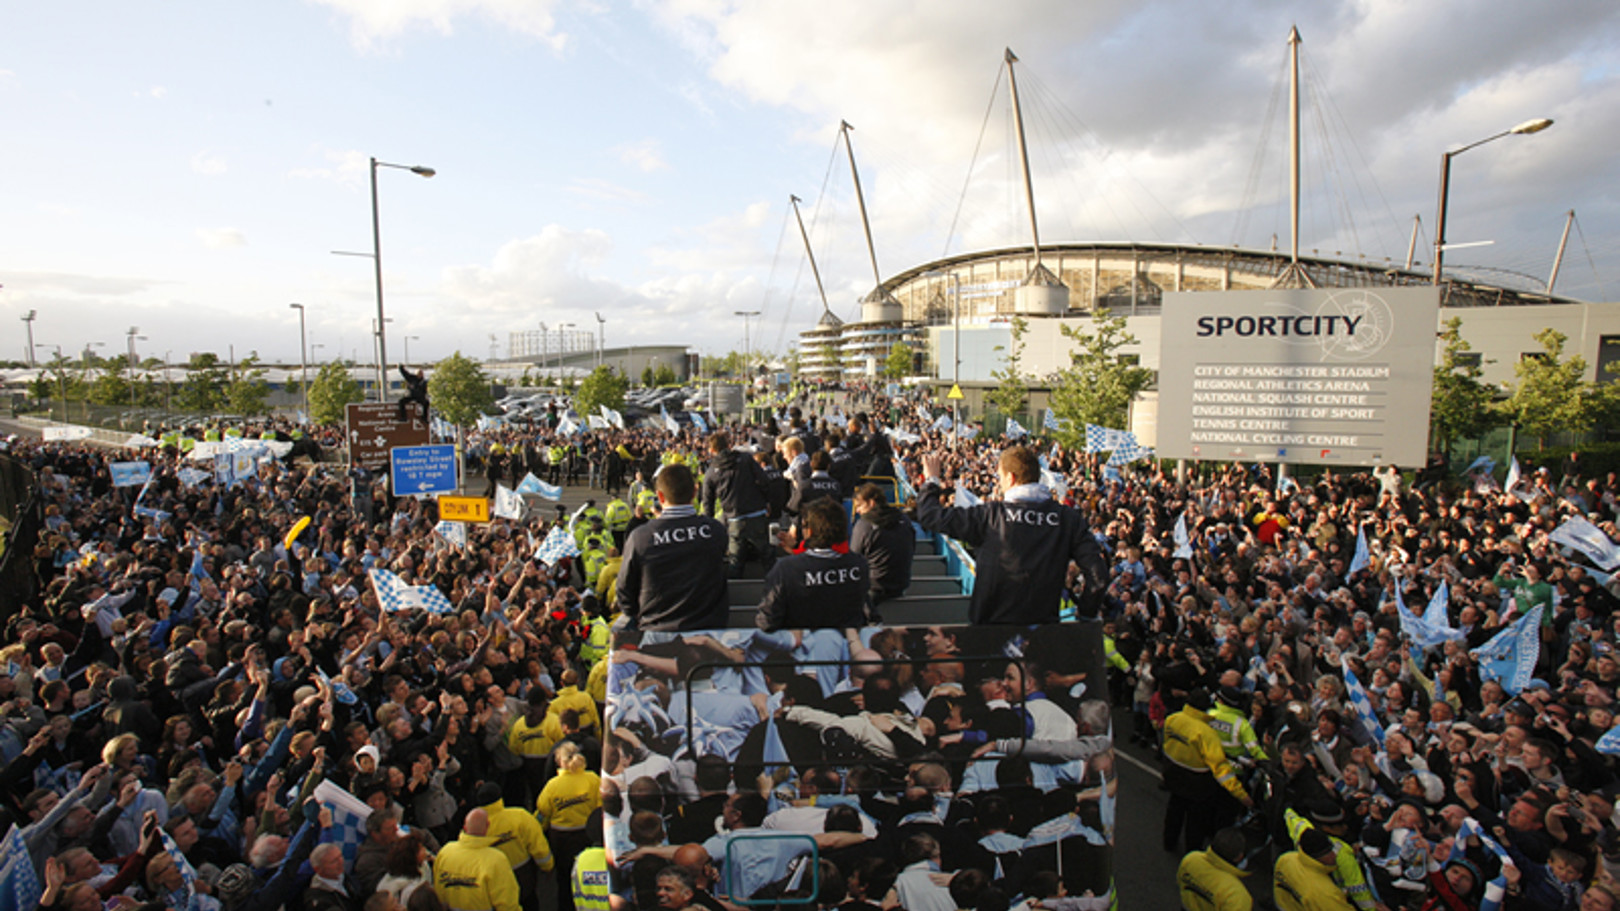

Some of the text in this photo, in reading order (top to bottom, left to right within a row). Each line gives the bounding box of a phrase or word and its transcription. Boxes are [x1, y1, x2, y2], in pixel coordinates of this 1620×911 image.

[1197, 315, 1362, 337] SPORTCITY
[1194, 366, 1390, 378] CITY OF MANCHESTER STADIUM
[1193, 380, 1370, 392] REGIONAL ATHLETICS ARENA
[1192, 392, 1367, 405] NATIONAL SQUASH CENTRE
[1192, 405, 1375, 419] ENGLISH INSTITUTE OF SPORT
[1193, 419, 1289, 430] TENNIS CENTRE
[1190, 431, 1358, 446] NATIONAL CYCLING CENTRE
[1004, 508, 1060, 526] MCFC
[652, 524, 712, 546] MCFC
[804, 566, 861, 587] MCFC
